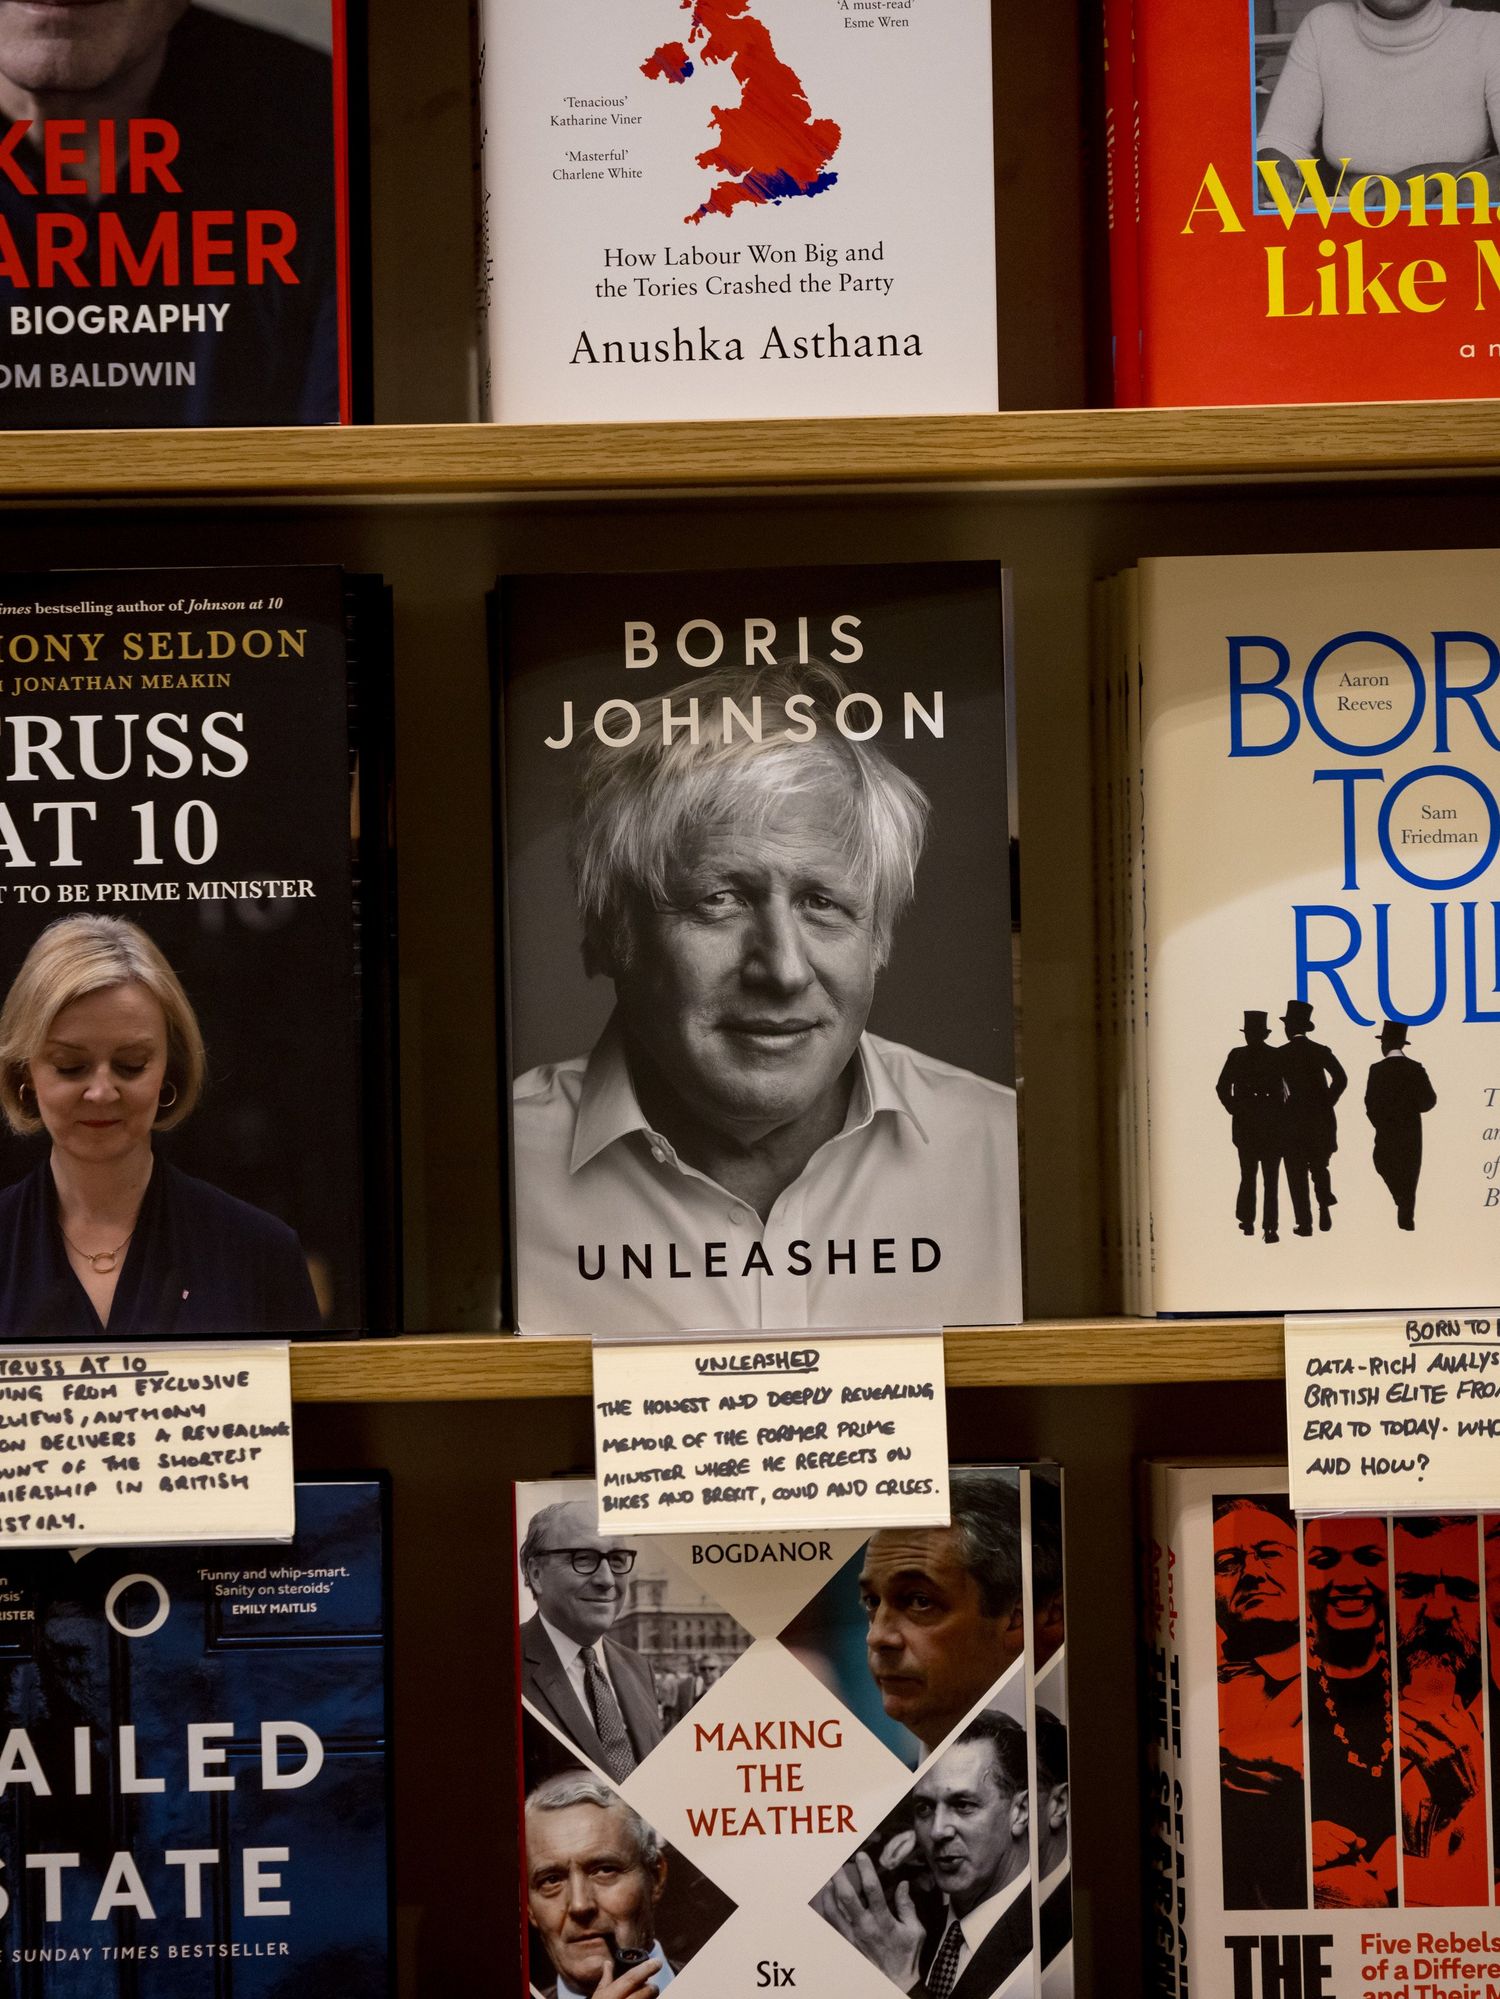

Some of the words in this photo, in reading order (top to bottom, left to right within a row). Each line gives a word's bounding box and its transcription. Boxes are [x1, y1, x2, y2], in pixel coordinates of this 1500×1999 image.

[844, 17, 875, 28] Esme
[878, 16, 909, 28] Wren
[563, 95, 628, 108] 'Tenacious'
[550, 112, 608, 127] Katharine
[610, 112, 642, 126] Viner
[565, 149, 629, 163] 'Masterful'
[552, 166, 605, 181] Charlene
[607, 166, 643, 180] White
[1180, 163, 1246, 234] A
[1254, 157, 1500, 231] Wom
[604, 247, 658, 268] How
[664, 244, 741, 266] Labour
[747, 243, 797, 265] Won
[804, 242, 839, 268] Big
[845, 240, 884, 262] and
[595, 277, 627, 298] the
[633, 276, 698, 297] Tories
[705, 274, 792, 295] Crashed
[799, 273, 832, 294] the
[838, 272, 895, 295] Party
[1264, 239, 1448, 318] Like
[10, 303, 231, 335] BIOGRAPHY
[568, 327, 745, 365] Anushka
[760, 323, 923, 361] Asthana
[50, 361, 196, 387] BALDWIN
[34, 601, 114, 616] bestselling
[116, 601, 165, 613] author
[168, 599, 187, 613] of
[185, 599, 246, 616] Johnson
[249, 598, 265, 610] at
[267, 597, 284, 610] 10
[0, 633, 104, 663] ONY
[123, 629, 308, 661] SELDON
[624, 614, 864, 669] BORIS
[11, 675, 133, 697] JONATHAN
[141, 673, 232, 690] MEAKIN
[1339, 672, 1390, 688] Aaron
[1337, 696, 1393, 712] Reeves
[544, 691, 944, 749] JOHNSON
[1421, 805, 1457, 821] Sam
[131, 800, 219, 866] 10
[1401, 828, 1479, 845] Friedman
[14, 885, 51, 903] TO
[57, 884, 90, 903] BE
[96, 882, 180, 902] PRIME
[186, 880, 317, 900] MINISTER
[1291, 901, 1500, 1026] RUL
[577, 1237, 942, 1280] UNLEASHED
[1406, 1320, 1460, 1342] BORN
[1464, 1319, 1491, 1336] TO
[80, 1356, 110, 1376] AT
[123, 1356, 147, 1372] 10
[695, 1349, 820, 1373] UNLEASHED
[1306, 1353, 1416, 1377] DATA-RICH
[63, 1384, 117, 1400] FROM
[135, 1371, 250, 1396] EXCLUSIVE
[1304, 1384, 1380, 1408] BRITISH
[1386, 1383, 1448, 1404] ELITE
[1456, 1380, 1500, 1399] FRO
[597, 1399, 632, 1417] THE
[643, 1397, 711, 1415] HONEST
[719, 1393, 758, 1410] AND
[767, 1386, 833, 1407] DEEPLY
[841, 1383, 934, 1404] REVEALING
[41, 1431, 136, 1450] DELIVERS
[155, 1428, 171, 1443] A
[182, 1421, 291, 1442] REVEALING
[603, 1434, 677, 1453] MEMOIR
[682, 1432, 707, 1449] OF
[714, 1430, 749, 1447] THE
[757, 1422, 828, 1445] FORMER
[837, 1421, 896, 1438] PRIME
[1303, 1420, 1342, 1441] ERA
[1347, 1421, 1371, 1437] TO
[1380, 1417, 1448, 1440] TODAY.
[62, 1459, 86, 1474] OF
[102, 1455, 140, 1471] THE
[158, 1447, 262, 1468] SHORTEST
[695, 1458, 751, 1478] WHERE
[762, 1456, 786, 1473] HE
[796, 1450, 877, 1471] REFLECTS
[887, 1447, 912, 1462] ON
[1306, 1457, 1351, 1475] AND
[1361, 1453, 1430, 1482] HOW?
[116, 1481, 142, 1495] IN
[159, 1473, 250, 1493] BRITISH
[602, 1493, 649, 1512] BIKES
[658, 1490, 694, 1507] AND
[772, 1483, 819, 1501] COVID
[827, 1479, 868, 1498] AND
[692, 1541, 833, 1564] BOGDANOR
[197, 1569, 240, 1584] 'Funny
[243, 1567, 267, 1580] and
[269, 1566, 350, 1582] whip-smart.
[215, 1584, 257, 1598] Sanity
[259, 1585, 273, 1594] on
[275, 1582, 334, 1594] steroids'
[232, 1604, 267, 1615] EMILY
[269, 1603, 317, 1614] MAITLIS
[694, 1719, 843, 1752] MAKING
[736, 1764, 804, 1793] THE
[686, 1805, 858, 1837] WEATHER
[0, 1847, 291, 1922] TATE
[12, 1948, 93, 1963] SUNDAY
[102, 1945, 160, 1960] TIMES
[168, 1942, 290, 1959] BESTSELLER
[1360, 1933, 1411, 1955] Five
[756, 1961, 796, 1988] Six
[1224, 1934, 1336, 1999] THE
[1361, 1958, 1389, 1981] of
[1394, 1965, 1409, 1980] a
